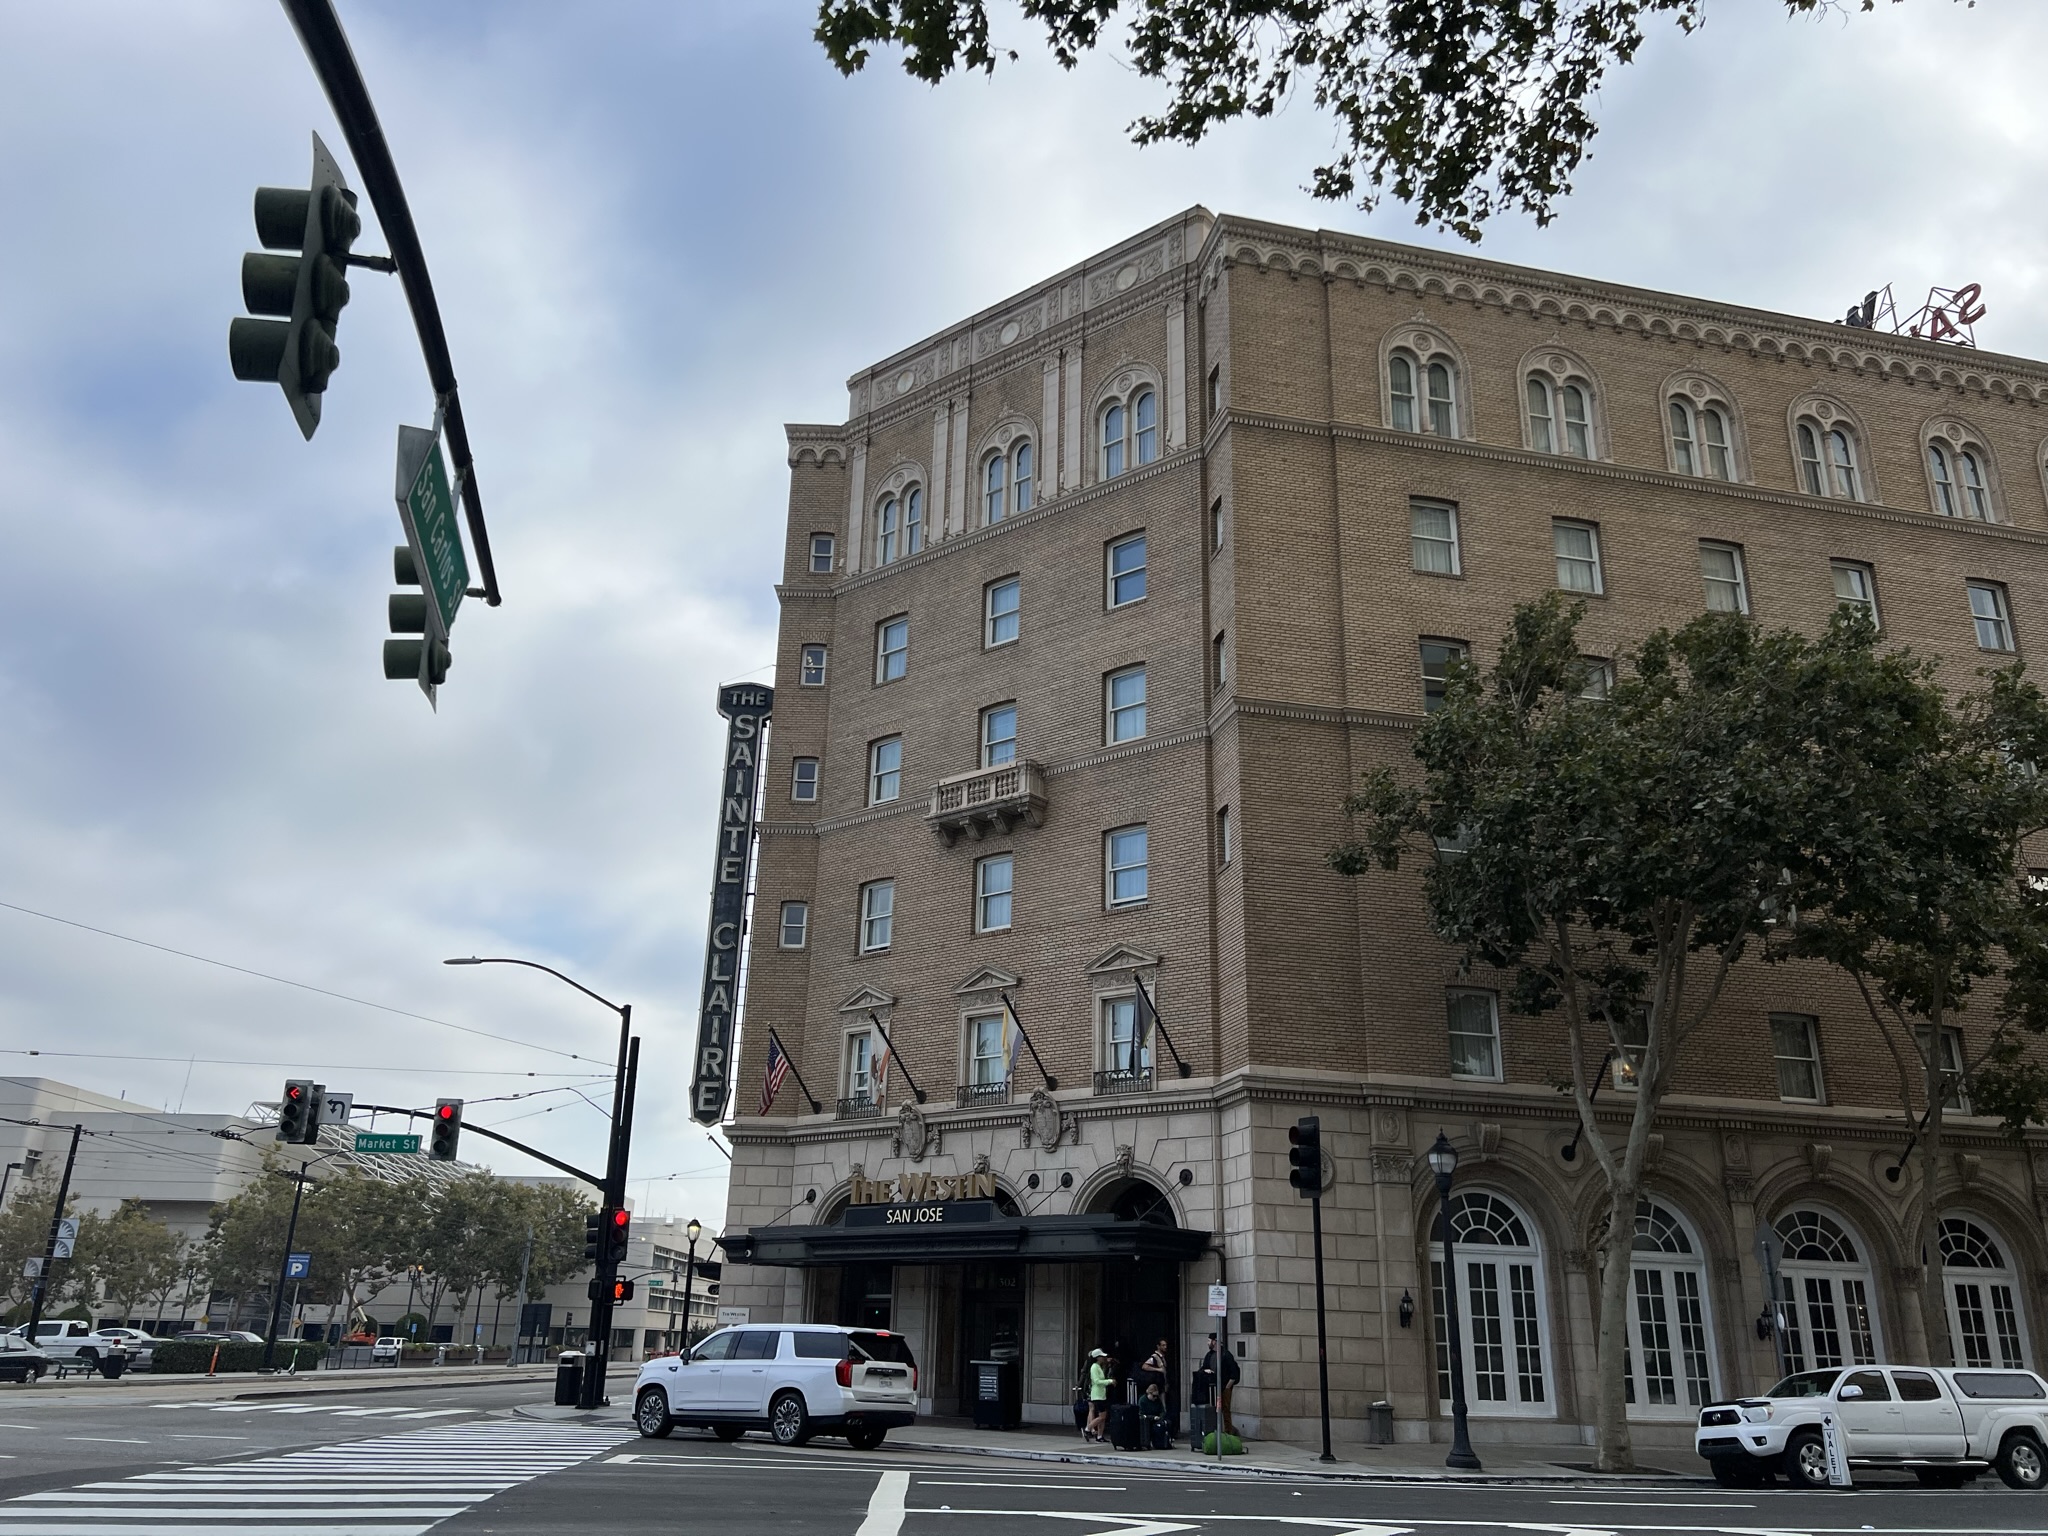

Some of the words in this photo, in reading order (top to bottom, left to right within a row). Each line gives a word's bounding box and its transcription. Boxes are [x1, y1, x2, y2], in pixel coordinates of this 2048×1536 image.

[417, 463, 437, 524] San
[430, 512, 455, 589] Carlos
[448, 578, 464, 617] St
[729, 690, 766, 706] THE
[719, 714, 757, 884] SAINTE
[696, 922, 738, 1112] CLAIRE
[358, 1138, 397, 1149] Market
[403, 1139, 416, 1149] St
[849, 1175, 895, 1205] THE
[898, 1172, 997, 1202] WESTIN
[886, 1209, 911, 1224] SAN
[913, 1207, 944, 1223] JOSE
[290, 1262, 303, 1276] P
[1826, 1431, 1837, 1475] VALET
